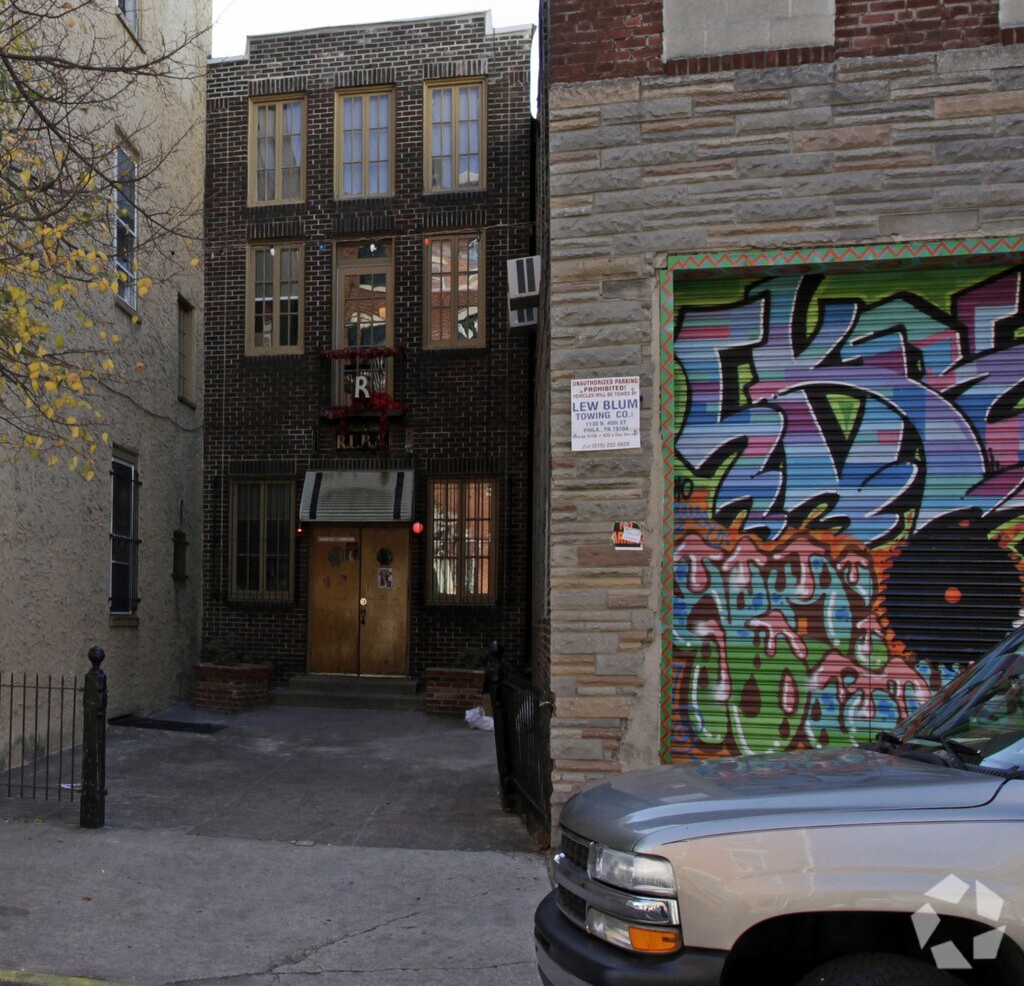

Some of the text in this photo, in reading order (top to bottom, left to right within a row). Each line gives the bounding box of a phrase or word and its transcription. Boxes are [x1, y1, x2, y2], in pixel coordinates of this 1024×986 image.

[354, 375, 370, 398] R
[573, 399, 638, 412] LEW BLUM
[576, 411, 610, 420] TOWING
